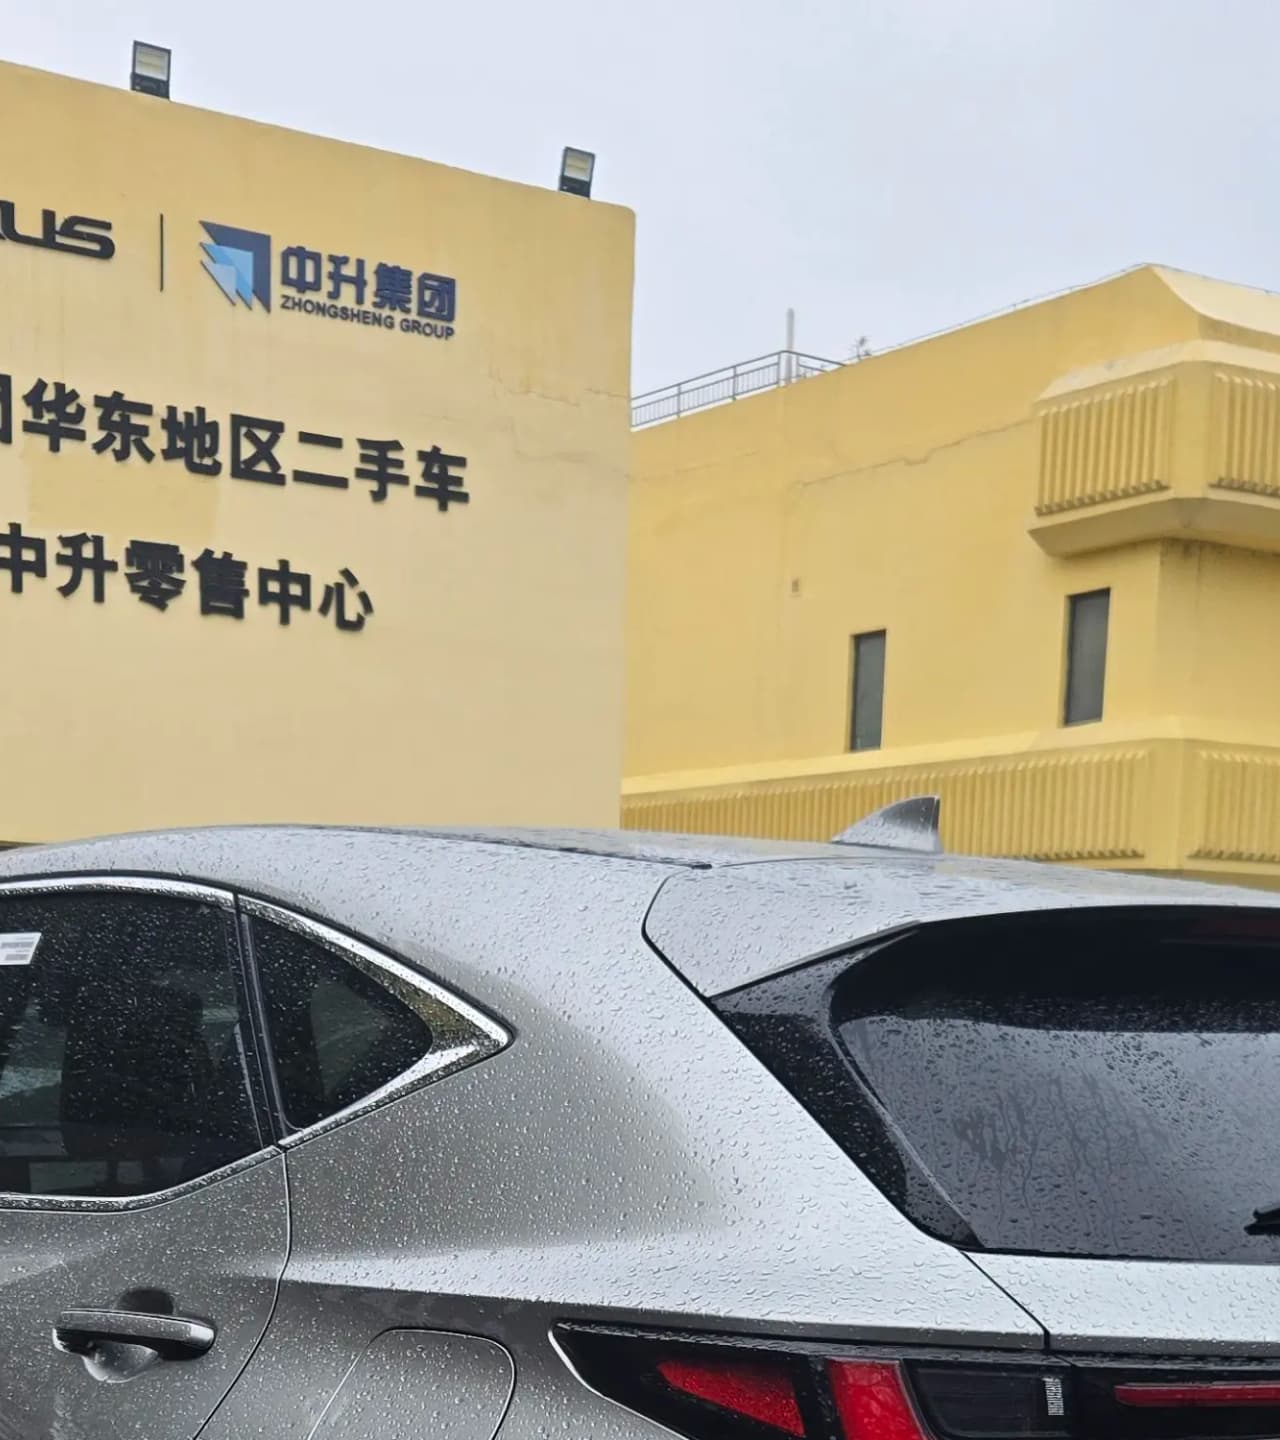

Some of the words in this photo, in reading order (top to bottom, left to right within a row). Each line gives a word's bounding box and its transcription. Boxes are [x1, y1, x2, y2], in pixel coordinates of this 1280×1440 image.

[281, 245, 456, 323] 中升集团
[280, 294, 396, 330] ZHONGSHENG
[400, 317, 456, 341] GROUP
